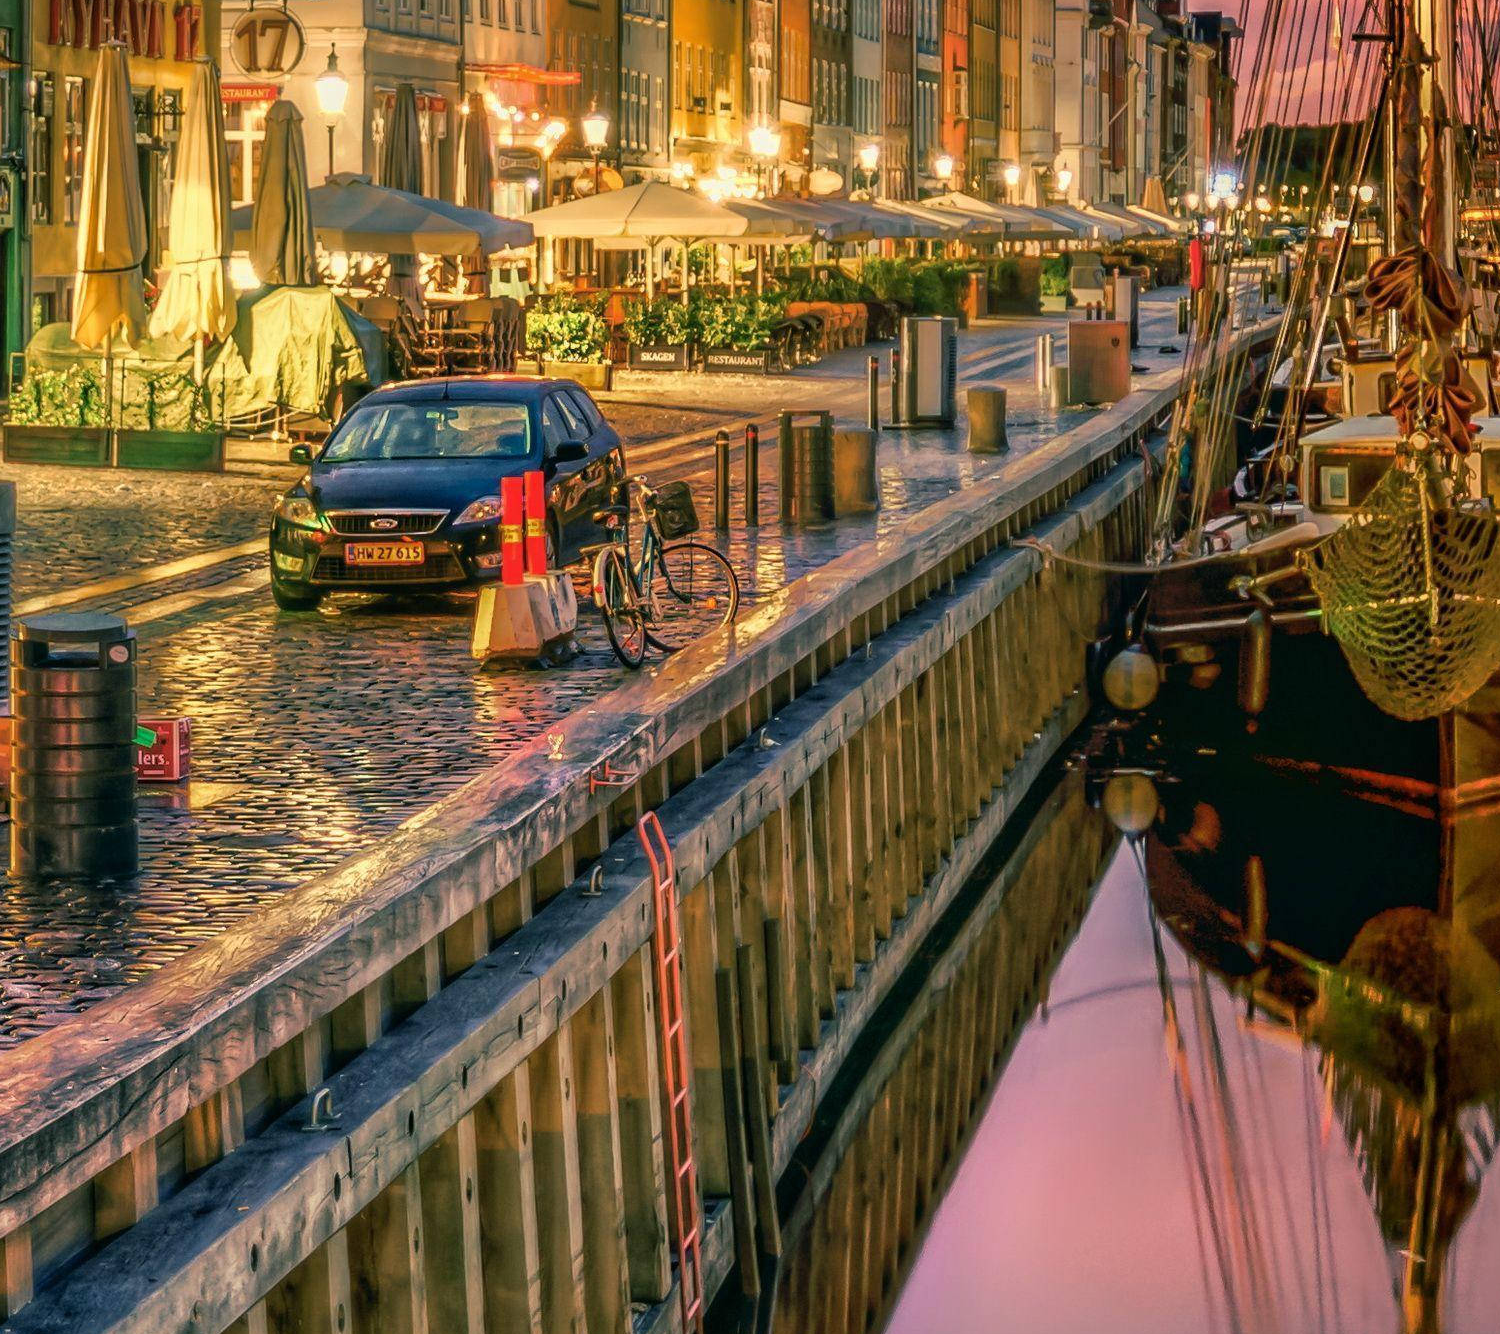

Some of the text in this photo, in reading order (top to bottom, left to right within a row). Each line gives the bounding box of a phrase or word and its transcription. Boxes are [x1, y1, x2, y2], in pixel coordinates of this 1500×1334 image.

[235, 18, 291, 73] 17
[221, 88, 272, 99] ESTAURANT
[640, 351, 764, 366] SKAGEN RESTAURANT
[357, 547, 421, 560] HW 27 615
